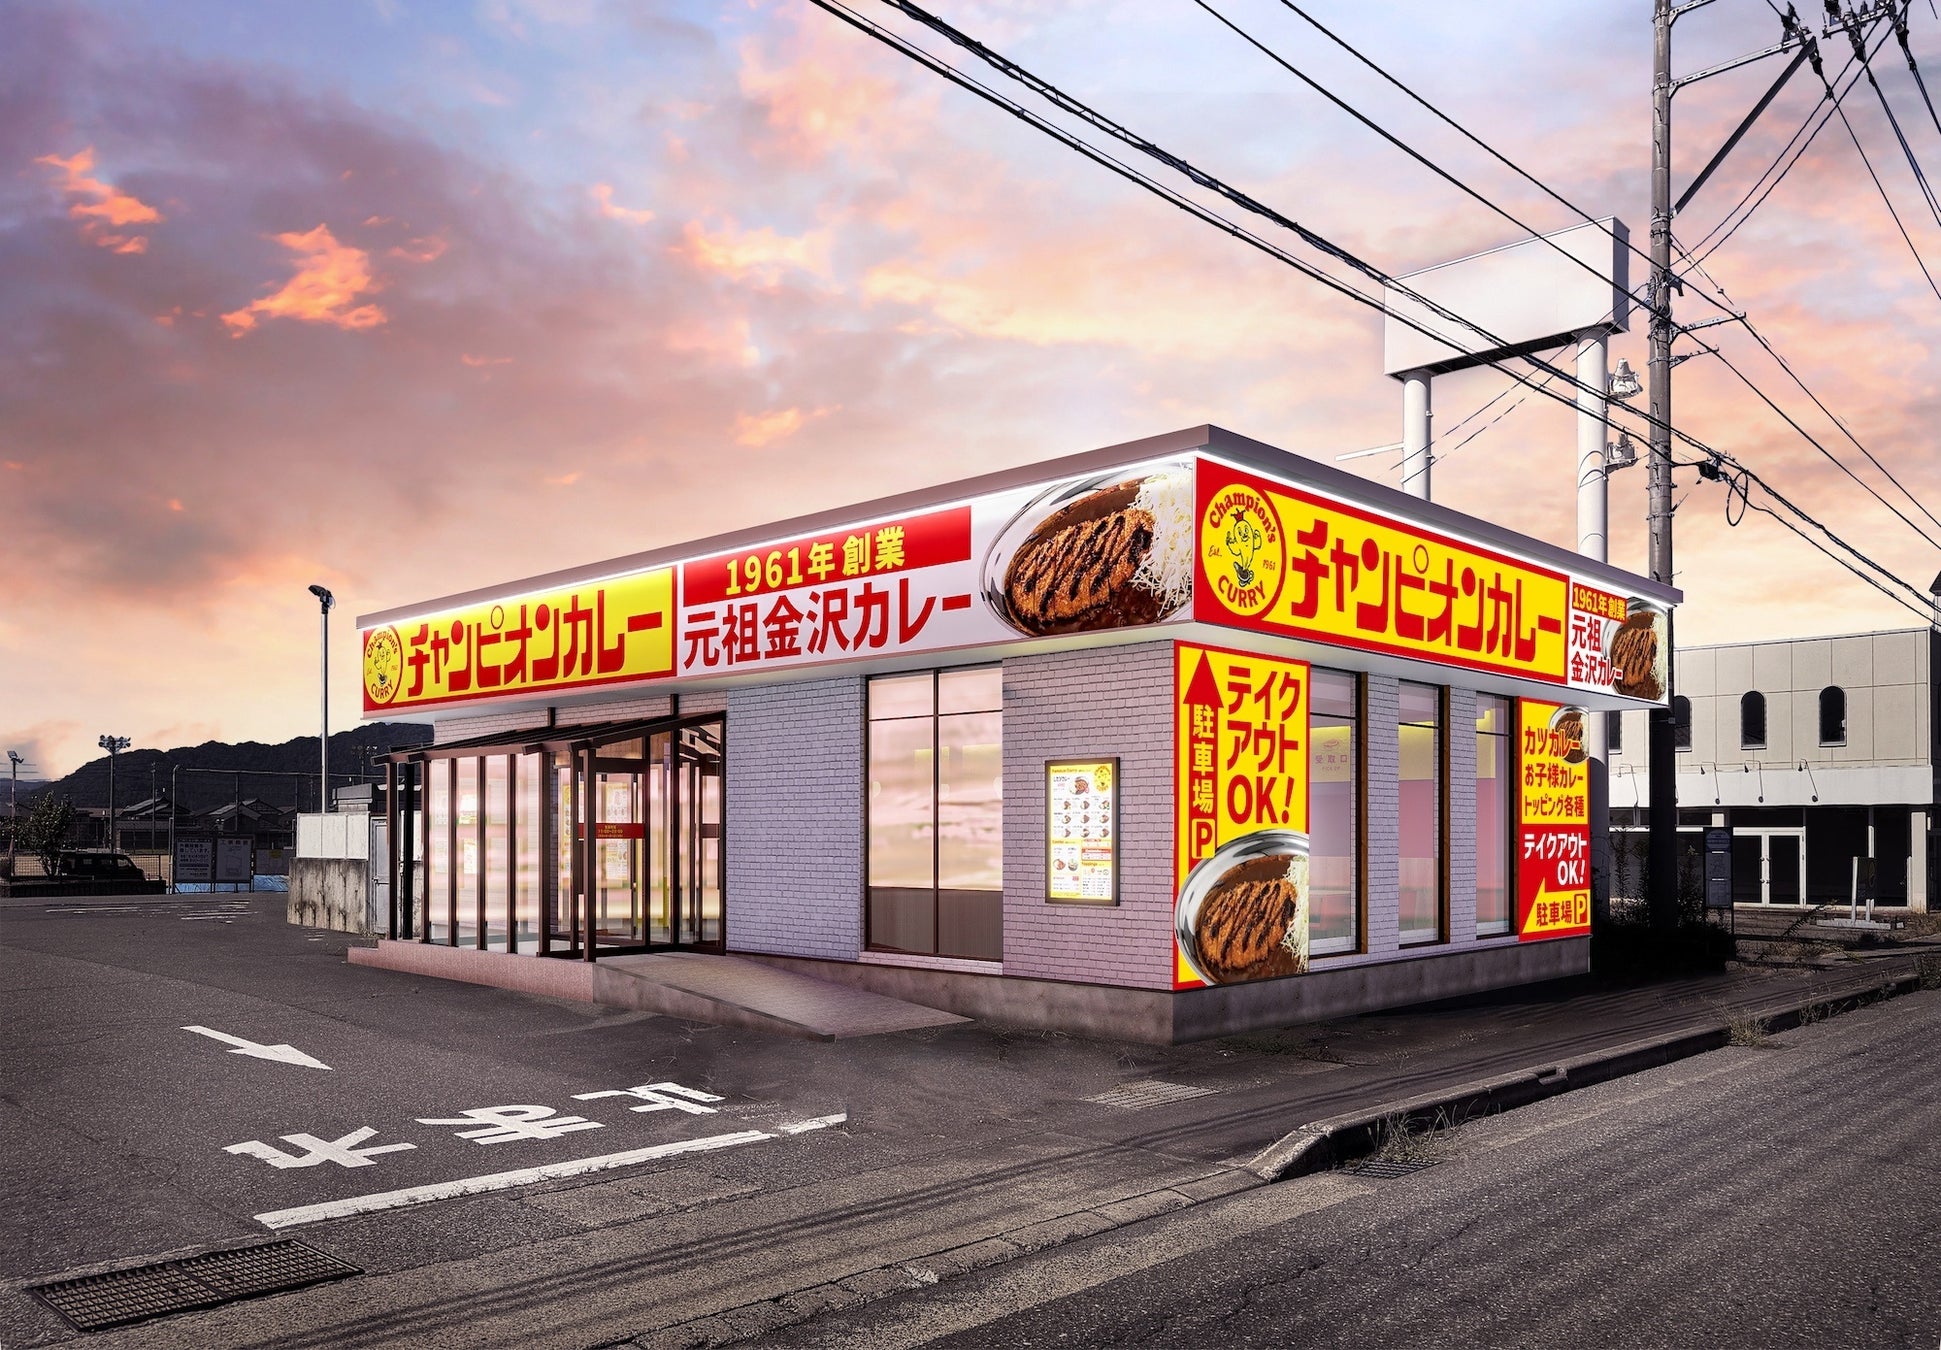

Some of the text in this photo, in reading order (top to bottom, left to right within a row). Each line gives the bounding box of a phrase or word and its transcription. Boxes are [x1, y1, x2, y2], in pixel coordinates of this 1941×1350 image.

[1209, 492, 1276, 544] Champion's
[726, 525, 906, 596] 1961年創業
[1218, 574, 1266, 608] CURRY
[1291, 518, 1561, 663] チャンピオンカレー
[408, 589, 662, 698] チャンピオンカレー
[683, 577, 972, 670] 元祖金沢カレー
[1571, 615, 1601, 651] 元祖
[371, 680, 394, 700] CURRY
[1570, 651, 1622, 686] 金沢カレー
[1227, 666, 1301, 722] テイク
[1192, 704, 1214, 815] 駐車場
[1226, 720, 1299, 773] アウト
[1524, 725, 1581, 759] カツカレー
[1524, 762, 1584, 789] お子様カレー
[1226, 774, 1295, 825] OK!
[1524, 793, 1585, 818] トッピング各種
[1524, 832, 1588, 860] テイクアウト
[1557, 859, 1586, 886] OK!
[1536, 899, 1573, 927] 駐車場
[221, 1082, 726, 1169] 止まれ
